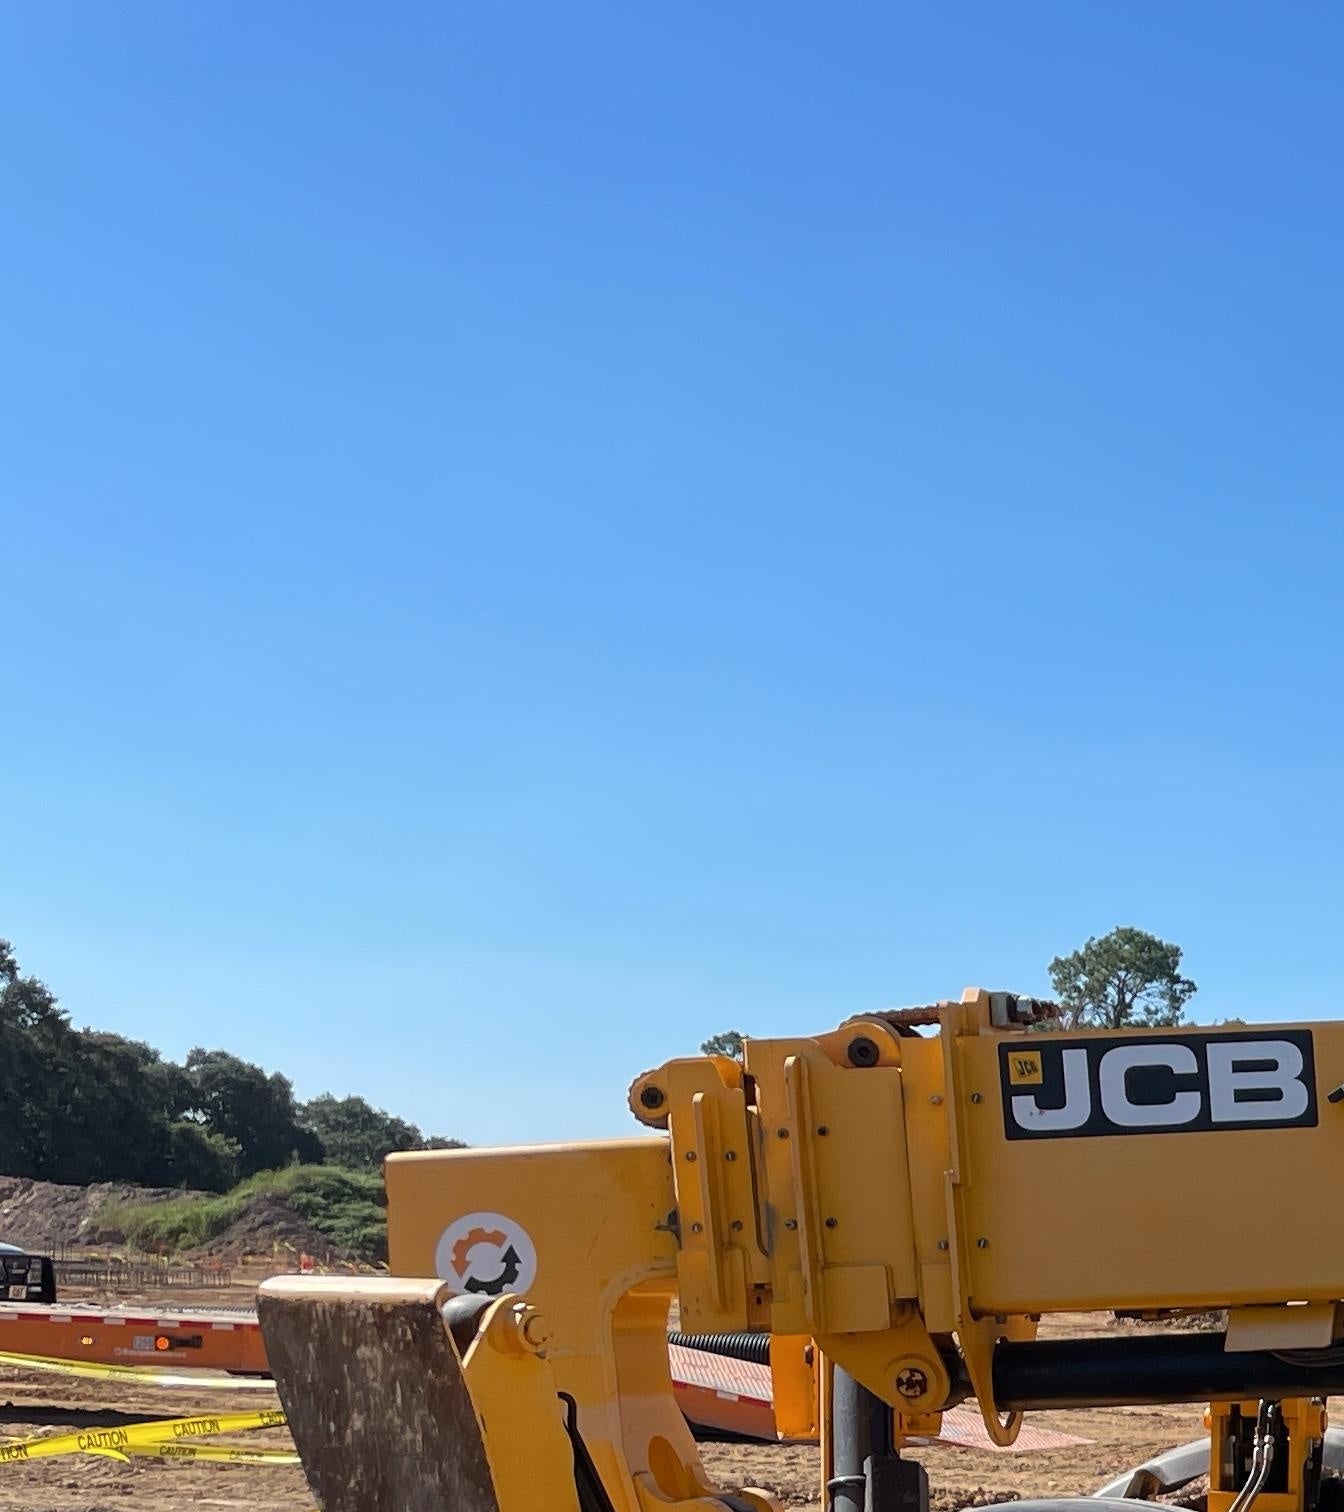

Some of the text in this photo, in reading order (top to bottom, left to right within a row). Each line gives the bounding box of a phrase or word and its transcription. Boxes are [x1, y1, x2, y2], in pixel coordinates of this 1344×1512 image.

[1011, 1040, 1309, 1131] JCB
[77, 1430, 129, 1450] CAUTION
[172, 1419, 221, 1438] CAUTION
[159, 1445, 197, 1459] CAUTION
